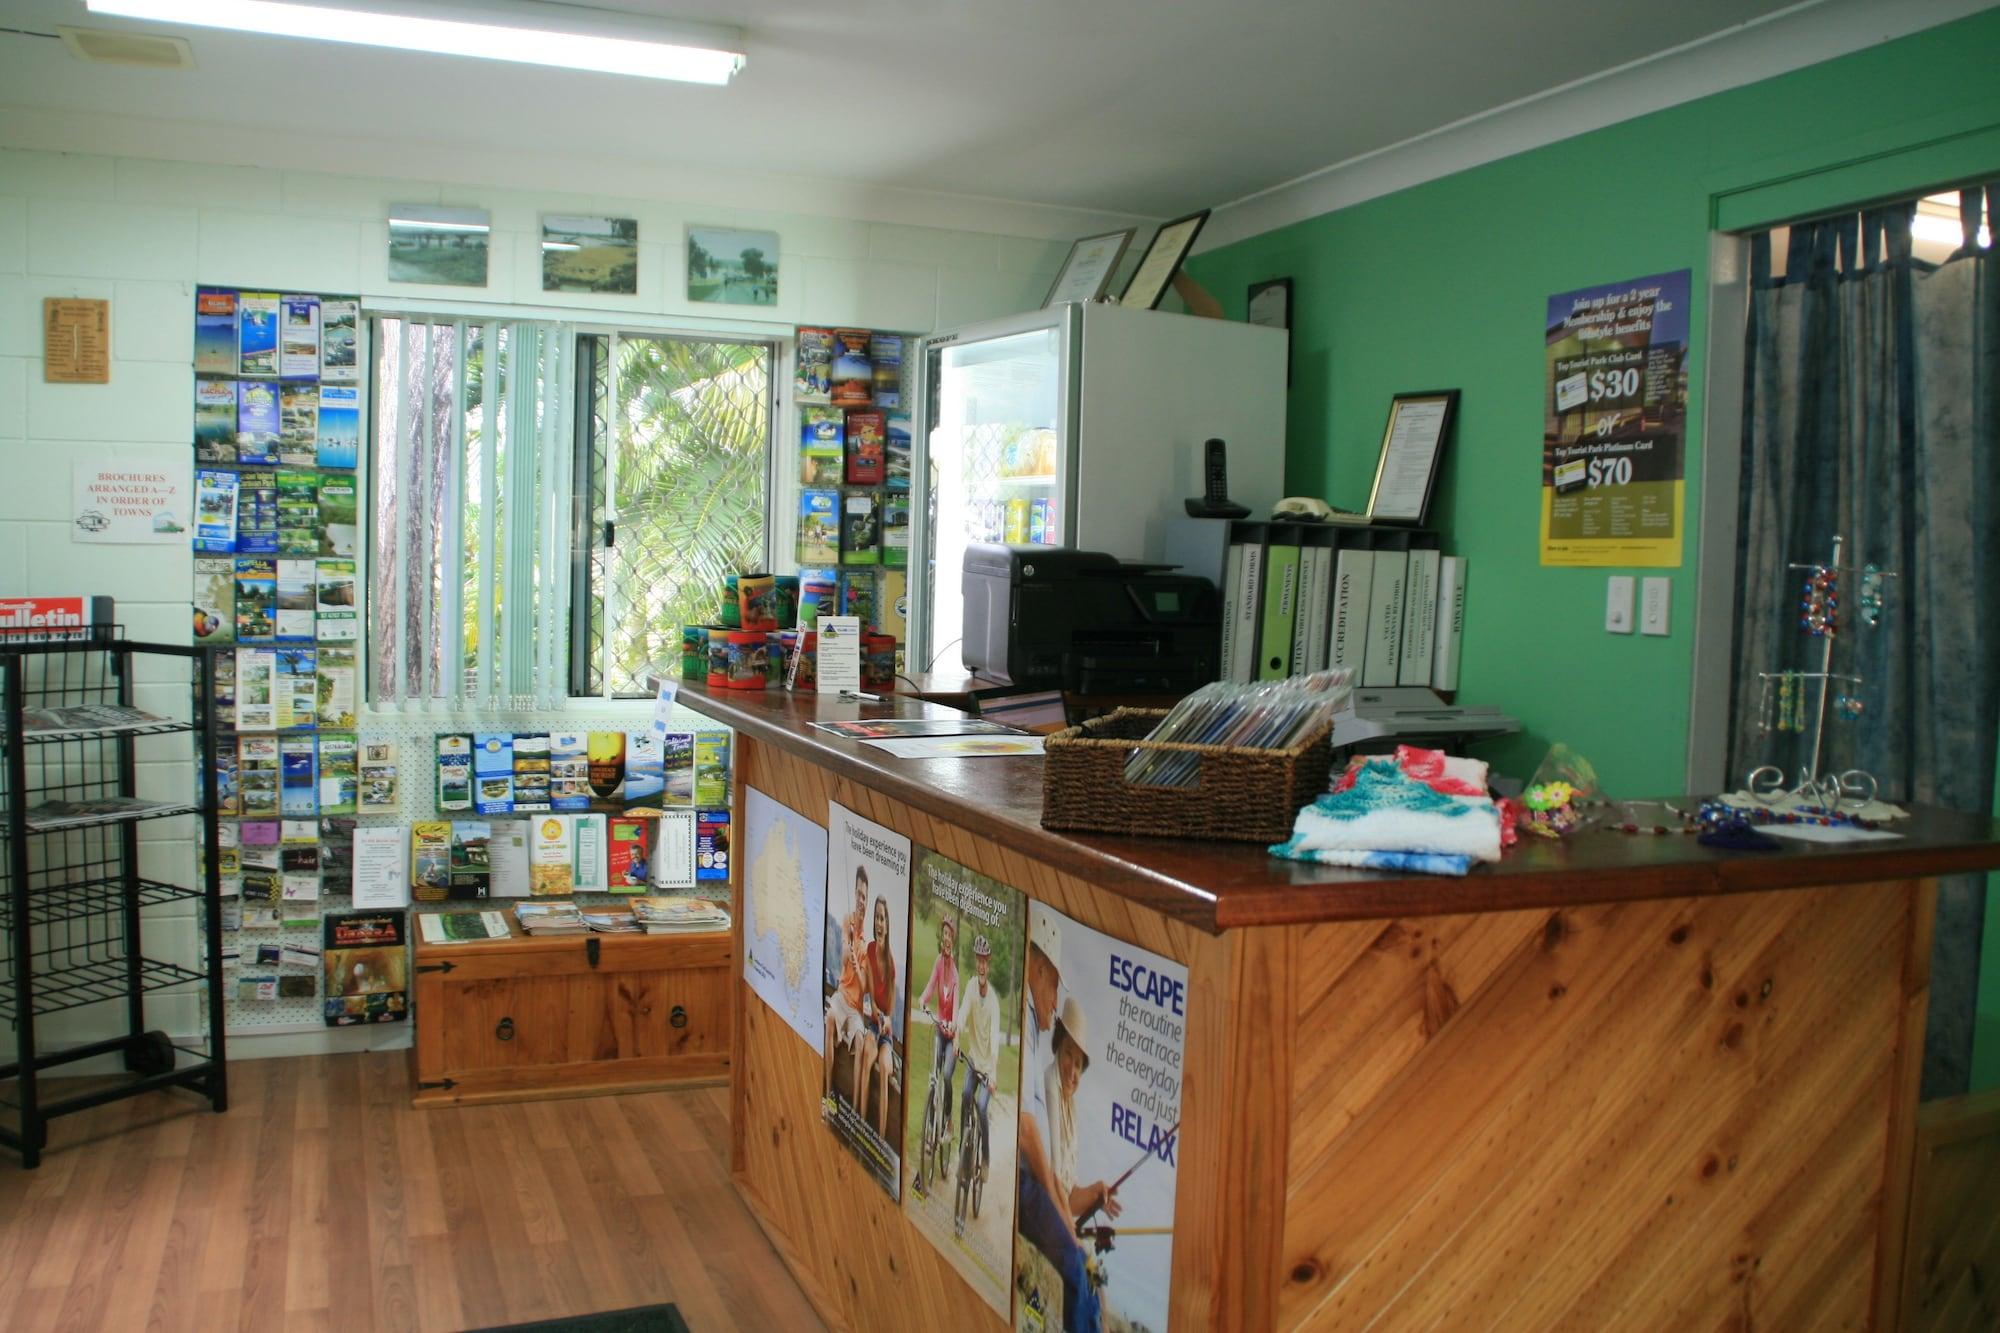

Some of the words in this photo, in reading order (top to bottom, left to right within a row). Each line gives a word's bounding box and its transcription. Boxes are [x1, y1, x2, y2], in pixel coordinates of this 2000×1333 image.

[1563, 310, 1616, 329] Membership
[1617, 306, 1628, 319] &
[1628, 303, 1655, 318] enjoy
[1655, 299, 1673, 313] the
[1572, 299, 1590, 313] Join
[1592, 299, 1605, 312] up
[1606, 294, 1621, 306] for
[1631, 287, 1637, 300] 2
[1638, 287, 1661, 302] year
[1615, 318, 1652, 336] benefits
[1590, 356, 1607, 366] Park
[1625, 351, 1643, 361] Card
[1590, 367, 1640, 402] $30
[1635, 440, 1654, 450] Card
[87, 484, 149, 494] ARRANGED
[97, 472, 166, 482] BROCHURES
[1587, 456, 1633, 489] $70
[96, 496, 108, 504] IN
[109, 496, 149, 505] ORDER
[112, 508, 152, 517] TOWNS
[1249, 550, 1257, 578] FORMS
[1245, 579, 1256, 620] STANDARD
[1392, 579, 1400, 614] RECORDS
[0, 608, 80, 628] ulletin
[1336, 573, 1350, 666] ACCREDITATION
[1383, 604, 1391, 640] VACATED
[1294, 640, 1304, 678] CTION
[850, 838, 861, 853] have
[863, 843, 875, 860] been
[875, 851, 900, 876] dreaming
[852, 825, 869, 847] holiday
[870, 837, 897, 858] experience
[897, 850, 907, 863] you
[928, 863, 938, 881] The
[938, 868, 959, 895] holiday
[958, 883, 993, 908] experience
[994, 900, 1008, 915] you
[932, 880, 945, 899] have
[959, 894, 990, 926] dreaming
[990, 913, 1001, 928] of.
[1109, 953, 1184, 1017] ESCAPE
[1119, 995, 1139, 1022] the
[1139, 1007, 1183, 1042] routine
[1116, 1020, 1137, 1047] the
[1137, 1036, 1155, 1057] rat
[1154, 1043, 1181, 1070] race
[1106, 1042, 1125, 1069] the
[1125, 1056, 1180, 1101] everyday
[1130, 1087, 1157, 1113] and
[1154, 1094, 1178, 1124] just
[1111, 1101, 1177, 1169] RELAX
